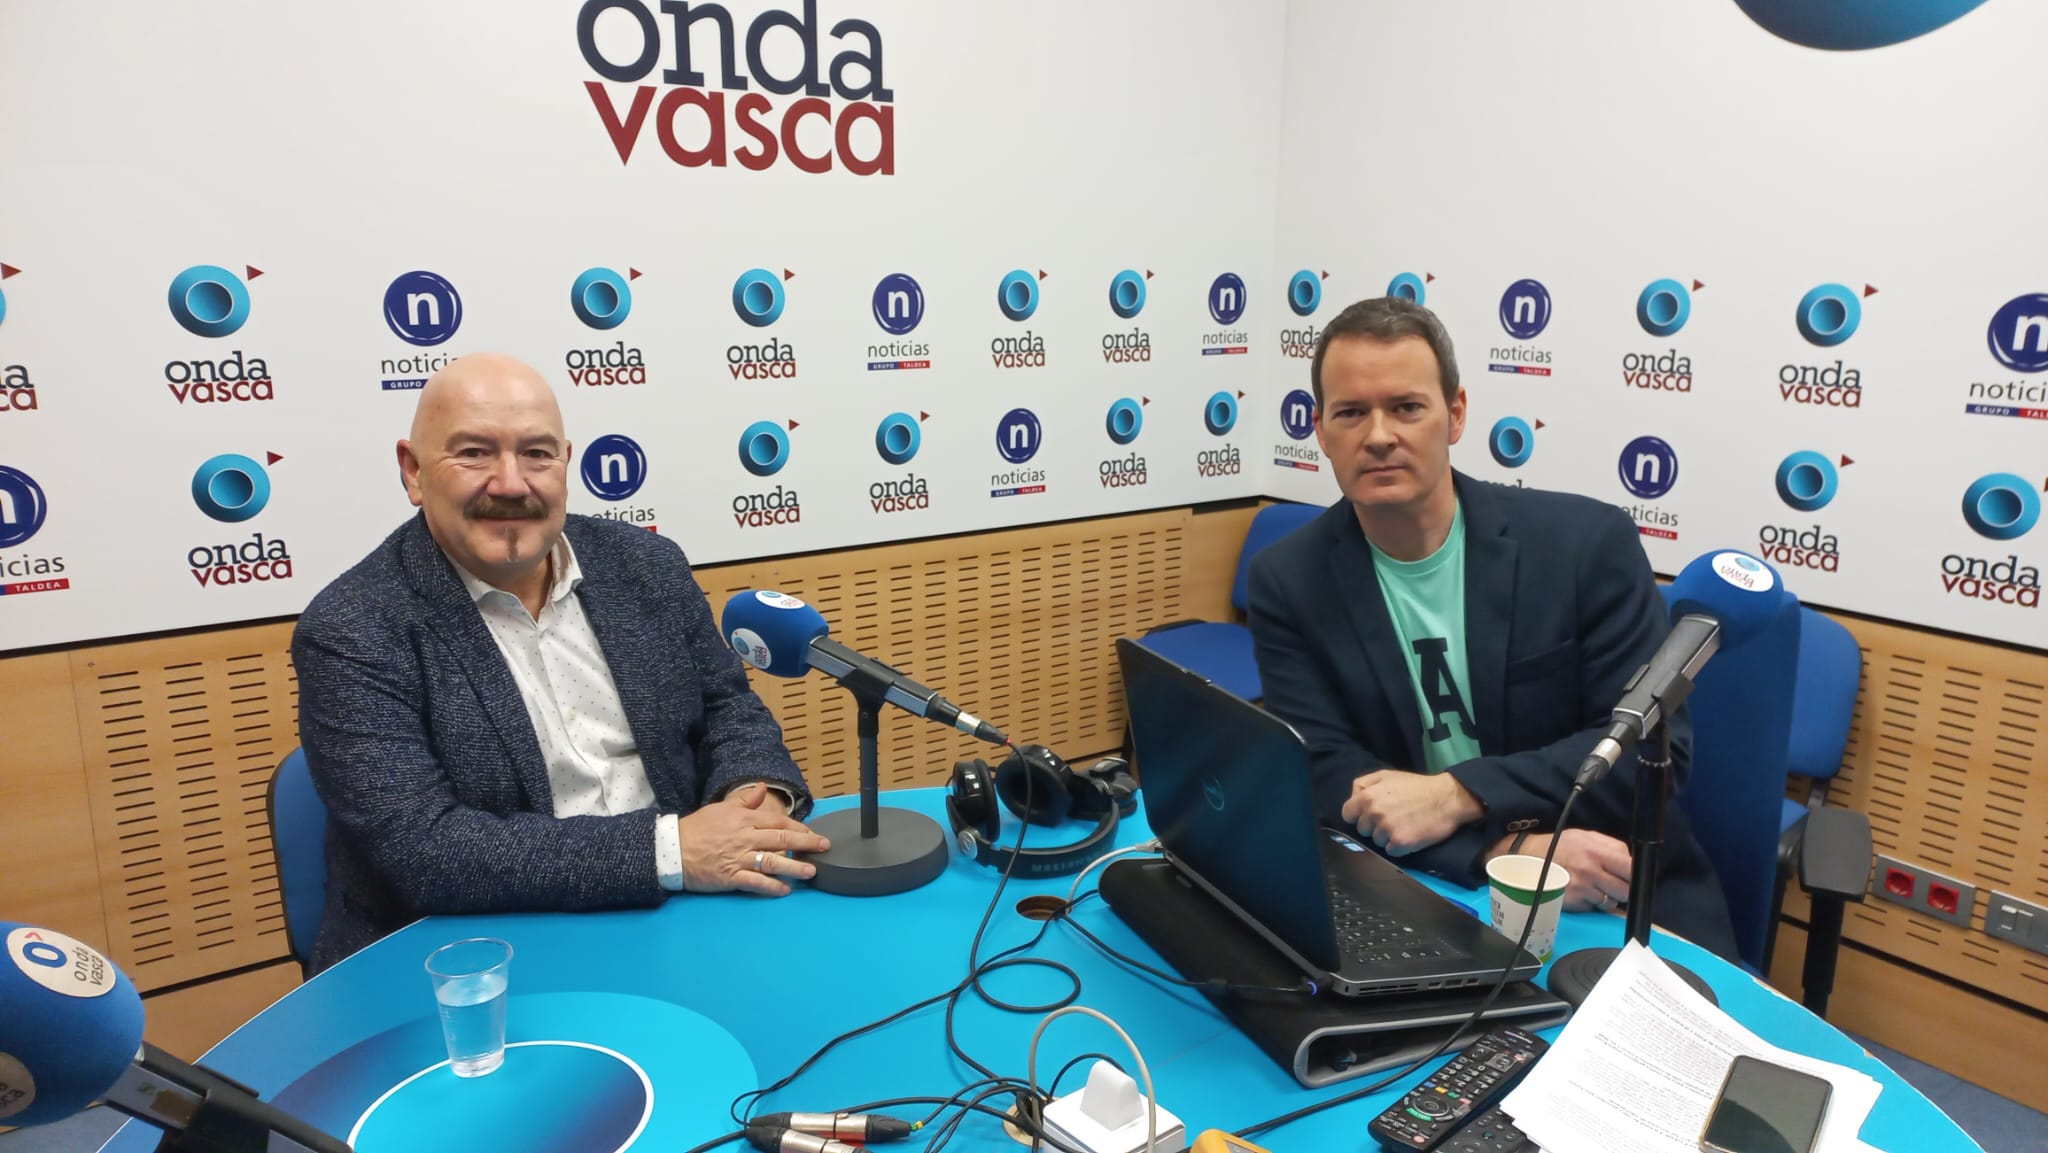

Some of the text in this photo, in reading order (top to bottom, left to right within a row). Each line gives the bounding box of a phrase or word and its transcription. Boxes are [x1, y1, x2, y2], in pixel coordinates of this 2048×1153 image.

[577, 0, 894, 103] onda
[583, 80, 895, 176] vasca
[407, 292, 440, 326] n
[888, 290, 910, 319] n
[1514, 295, 1537, 324] n
[868, 341, 930, 358] noticias
[991, 331, 1045, 354] onda
[1102, 327, 1150, 350] onda
[1202, 330, 1248, 345] noticias
[381, 352, 460, 374] notici
[566, 341, 645, 370] onda
[727, 337, 795, 364] onda
[992, 351, 1046, 368] vasca
[1103, 346, 1151, 363] vasca
[1280, 343, 1315, 360] vasc
[1490, 345, 1552, 364] noticias
[1623, 349, 1692, 376] onda
[165, 350, 271, 384] onda
[568, 366, 647, 387] vasca
[729, 360, 797, 381] vasca
[1779, 360, 1862, 391] onda
[168, 378, 275, 405] vasca
[1622, 370, 1692, 393] vasca
[1779, 384, 1861, 408] vasca
[1010, 424, 1029, 449] n
[1100, 452, 1147, 475] onda
[1197, 443, 1240, 465] onda
[1274, 443, 1319, 461] noticias
[601, 453, 628, 484] n
[992, 468, 1046, 487] noticias
[1100, 471, 1147, 488] vasca
[1198, 459, 1240, 477] vasca
[1635, 453, 1661, 483] n
[870, 473, 928, 499] onda
[733, 485, 799, 513] onda
[871, 491, 928, 513] vasca
[735, 506, 800, 528] vasca
[188, 532, 290, 568] onda
[1759, 525, 1839, 556] onda
[1759, 542, 1839, 573] vasca
[191, 559, 293, 587] vasca
[1942, 554, 2041, 590] onda
[15, 582, 61, 592] TALDEA
[1941, 573, 2040, 609] vasca
[1412, 637, 1479, 743] A
